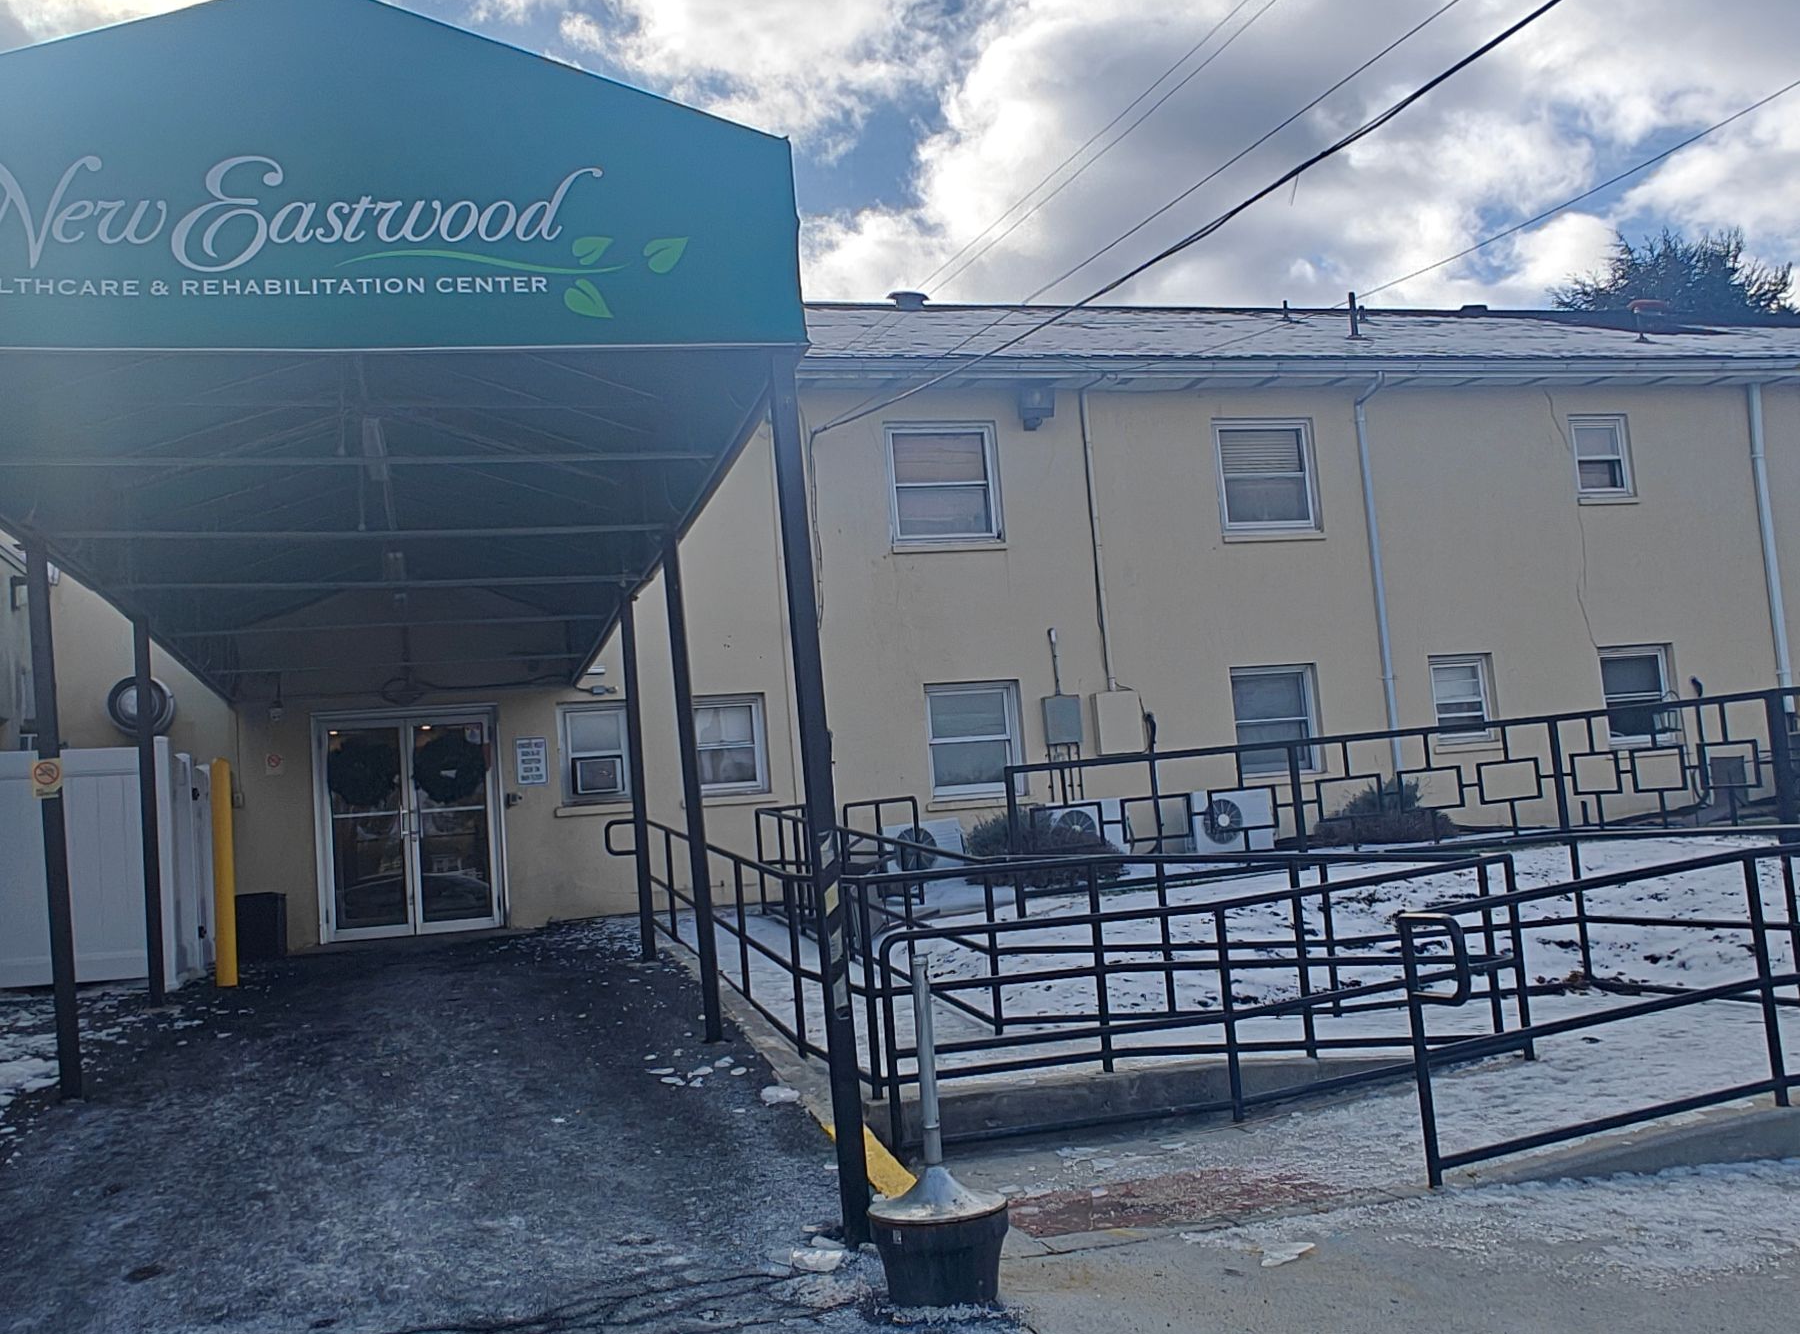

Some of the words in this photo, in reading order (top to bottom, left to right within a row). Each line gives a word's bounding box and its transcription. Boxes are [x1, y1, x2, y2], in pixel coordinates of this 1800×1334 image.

[0, 155, 167, 269] New
[170, 155, 604, 273] Eastwood
[150, 279, 170, 296] &
[182, 277, 425, 296] REHABILITATION
[435, 276, 549, 294] CENTER
